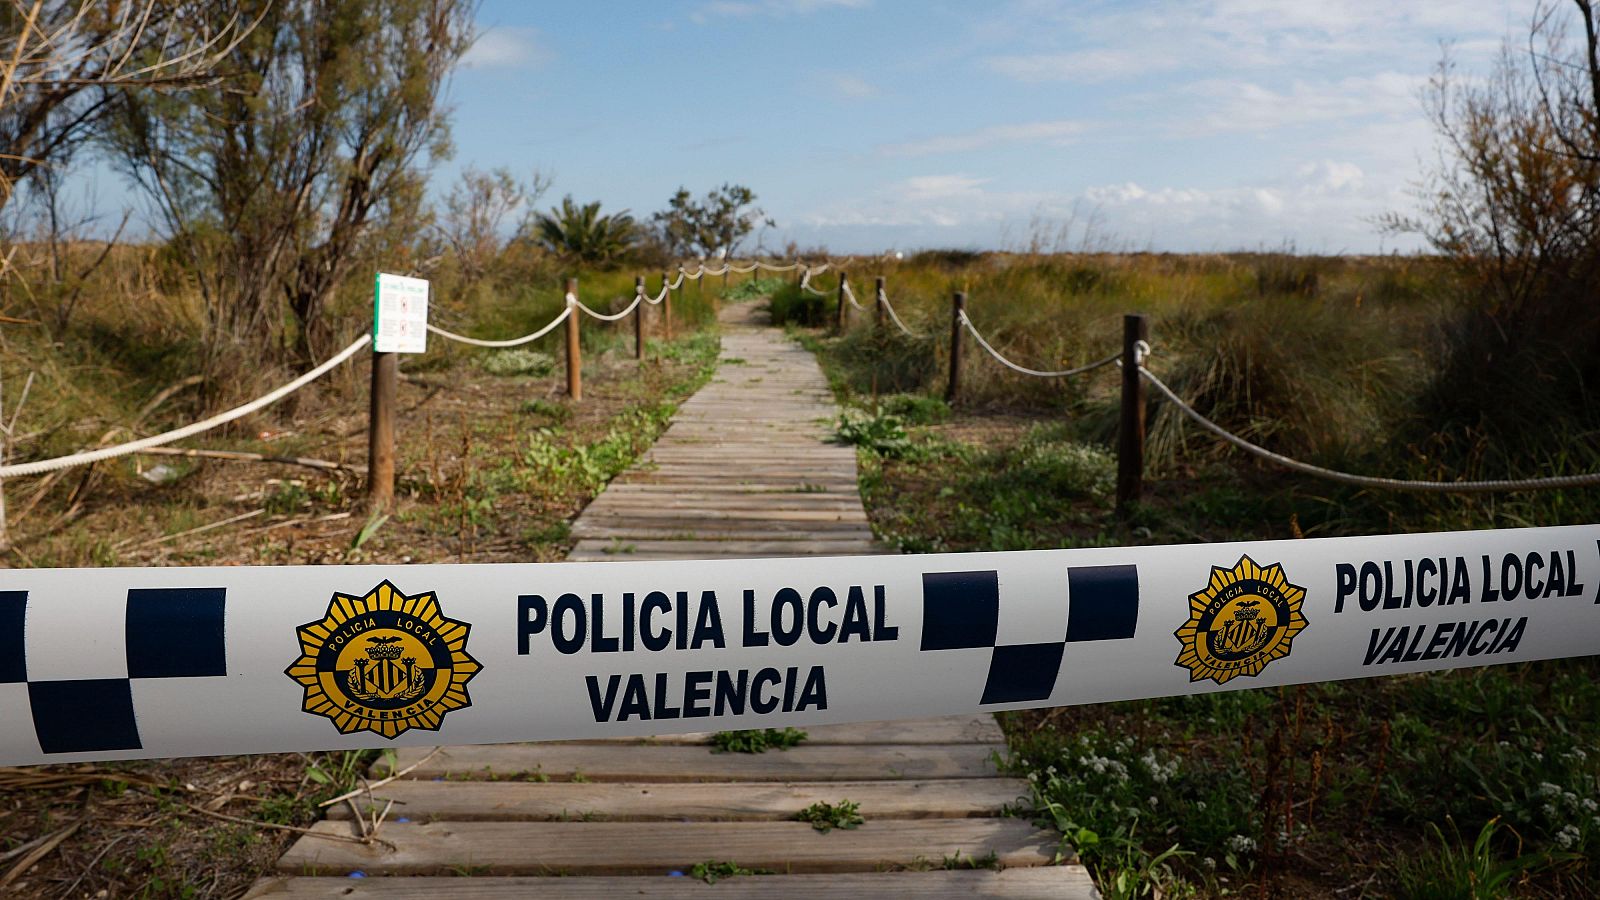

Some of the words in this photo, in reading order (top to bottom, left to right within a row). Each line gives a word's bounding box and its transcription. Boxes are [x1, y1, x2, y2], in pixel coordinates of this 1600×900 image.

[1209, 586, 1244, 615] POLICIA
[1257, 585, 1282, 608] LOCAL
[1334, 556, 1471, 613] POLICIA
[1481, 550, 1584, 603] LOCAL
[329, 617, 376, 652] POLICIA
[396, 617, 437, 647] LOCAL
[517, 590, 726, 655] POLICIA
[742, 584, 899, 648] LOCAL
[1204, 651, 1267, 669] VALENCIA
[1362, 616, 1528, 666] VALENCIA
[344, 699, 435, 720] VALENCIA
[585, 665, 828, 723] VALENCIA
